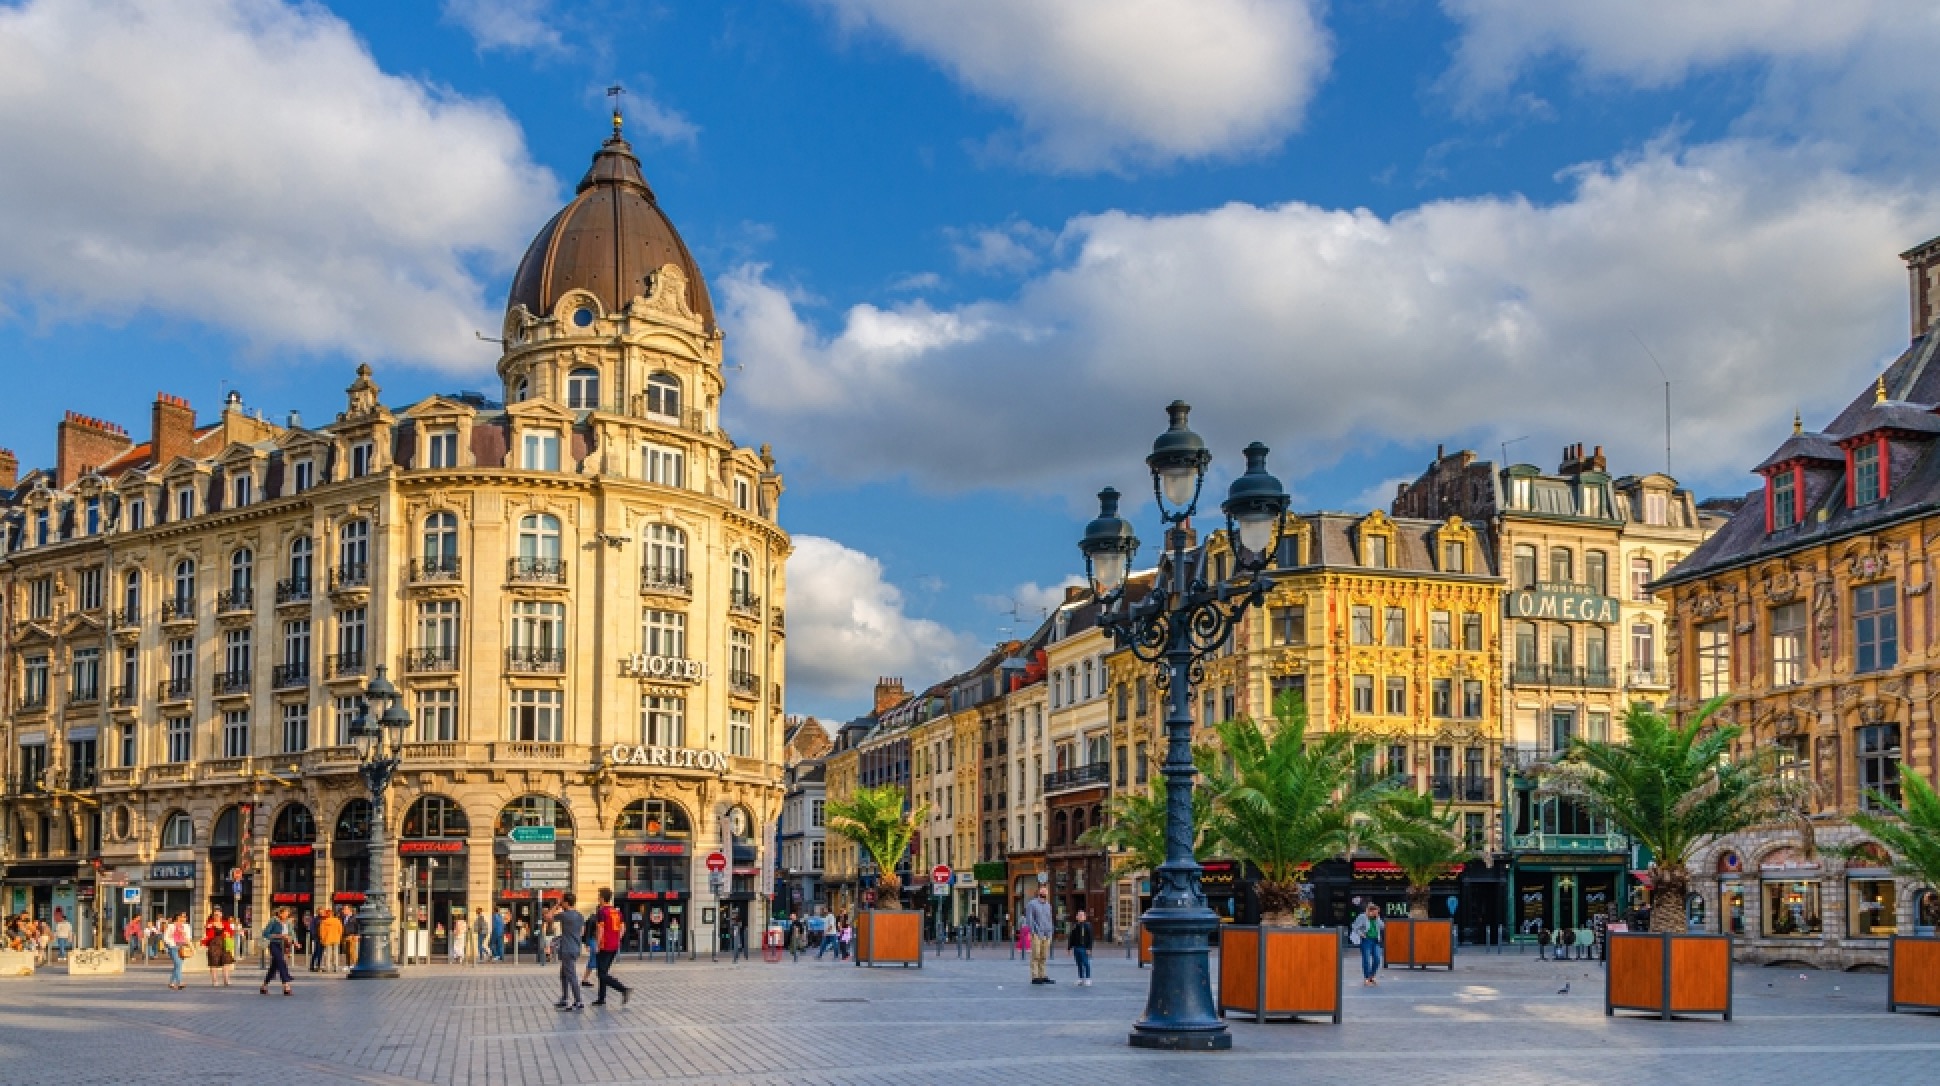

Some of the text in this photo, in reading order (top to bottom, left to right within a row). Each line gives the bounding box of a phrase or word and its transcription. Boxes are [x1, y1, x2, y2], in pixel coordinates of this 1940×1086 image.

[1519, 593, 1613, 622] OMEGA
[630, 653, 711, 680] HOTEL
[611, 743, 728, 769] CARLTON
